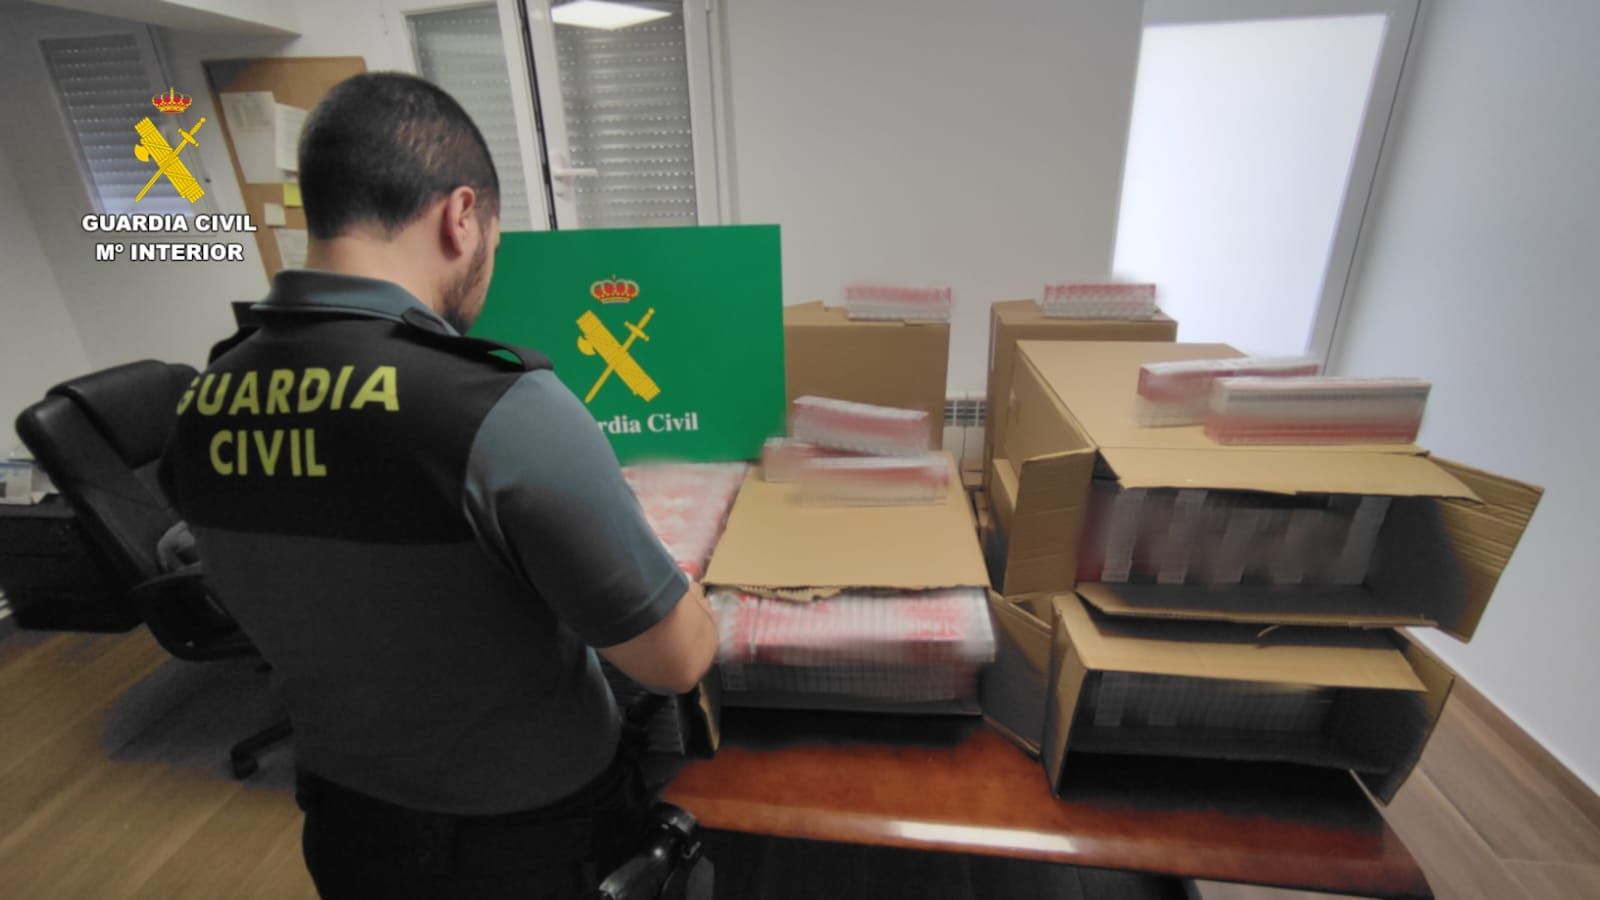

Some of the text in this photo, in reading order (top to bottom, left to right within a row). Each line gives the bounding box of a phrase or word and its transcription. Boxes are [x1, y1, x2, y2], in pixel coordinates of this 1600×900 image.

[176, 365, 400, 416] GUARDIA
[597, 411, 699, 434] rdia Civil
[209, 428, 327, 477] CIVIL
